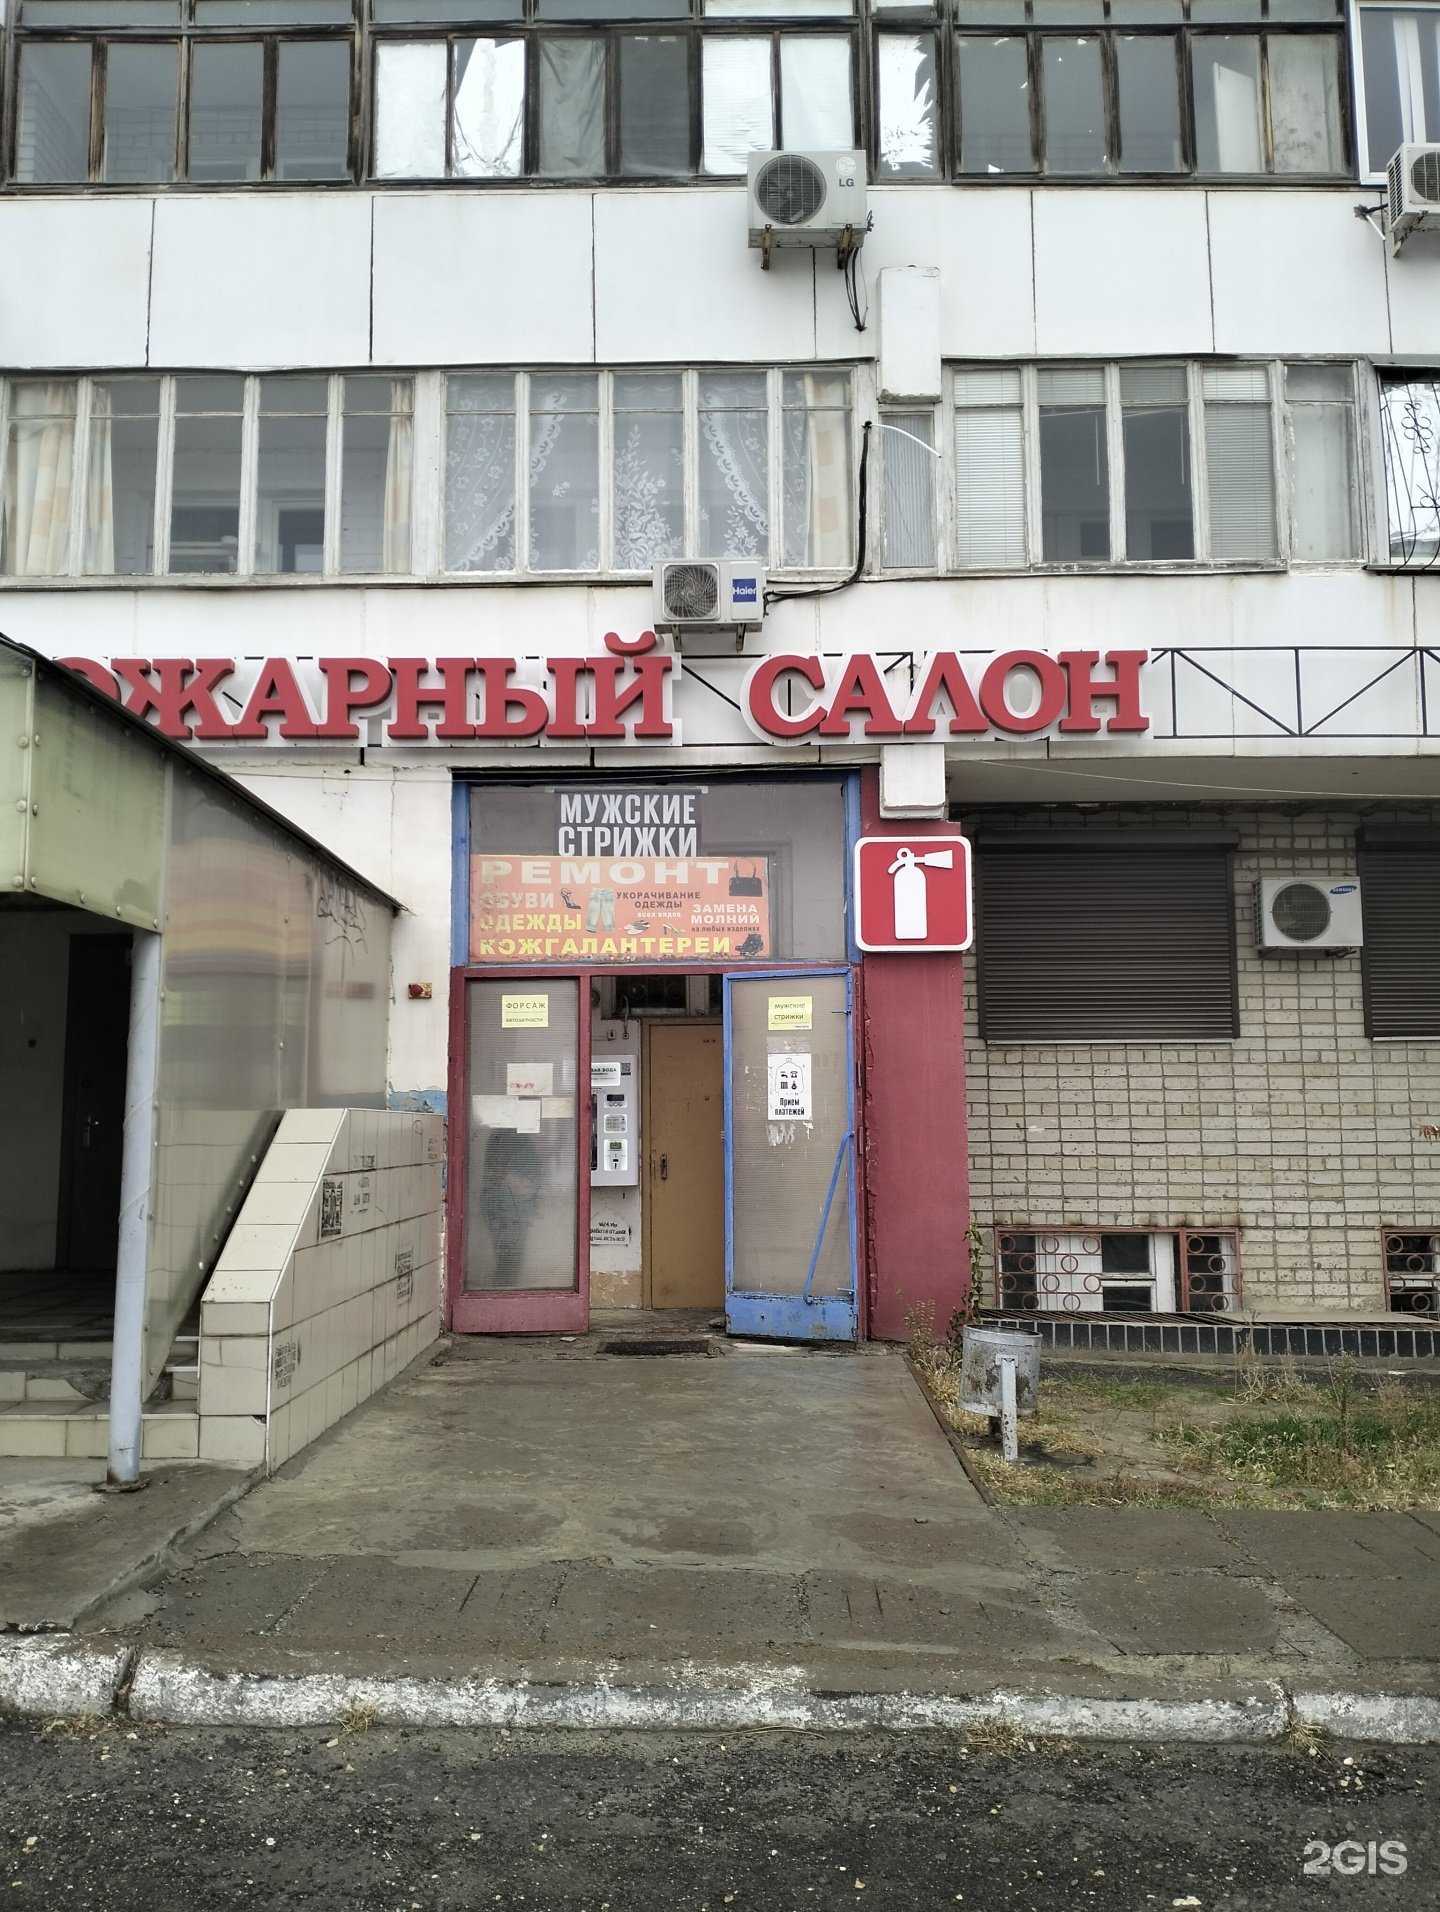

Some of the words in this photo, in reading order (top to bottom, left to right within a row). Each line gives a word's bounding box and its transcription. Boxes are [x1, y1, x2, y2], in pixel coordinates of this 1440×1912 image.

[839, 178, 855, 187] LG
[733, 587, 756, 595] Haier
[749, 650, 1150, 738] САЛОН
[560, 794, 696, 824] МУЖСКИЕ
[558, 826, 697, 857] СТРИЖКИ
[481, 861, 728, 885] РЕМОНТ
[616, 891, 702, 900] УКОРАЧИВАНИЕ
[634, 901, 682, 909] ОДЕЖДЫ
[692, 904, 757, 913] ЗАМЕНА
[691, 914, 760, 924] МОЛНИЙ
[480, 937, 730, 955] КОЖГАЛАНТЕРЕИ
